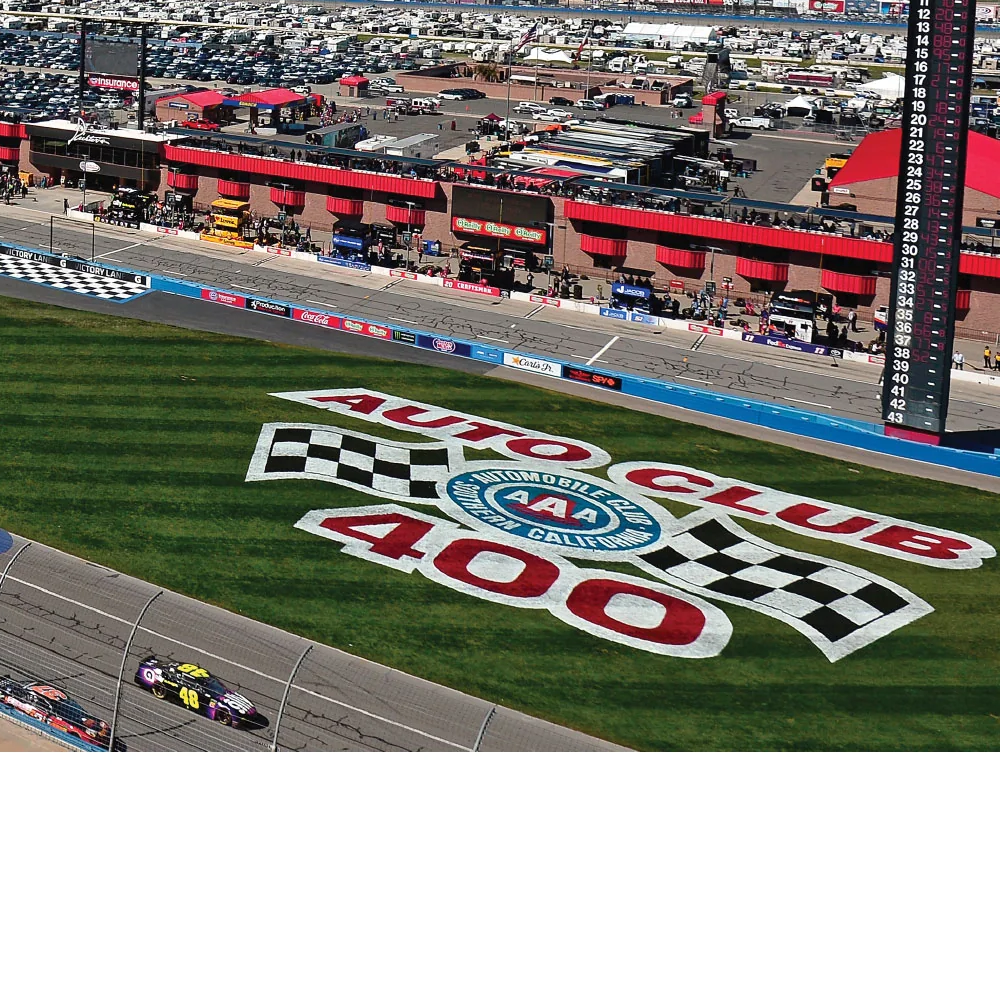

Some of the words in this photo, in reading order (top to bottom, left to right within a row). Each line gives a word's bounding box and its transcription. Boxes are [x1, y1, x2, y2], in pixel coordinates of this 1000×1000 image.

[917, 9, 930, 20] 12
[917, 22, 930, 33] 13
[916, 35, 929, 46] 14
[915, 48, 928, 59] 15
[914, 62, 928, 72] 16
[98, 77, 138, 89] Insurance
[913, 75, 926, 85] 17
[912, 88, 926, 98] 18
[912, 101, 925, 112] 19
[910, 114, 927, 125] 20
[910, 127, 923, 138] 21
[909, 140, 924, 151] 22
[908, 153, 923, 164] 23
[907, 166, 922, 177] 24
[906, 179, 921, 190] 25
[905, 192, 921, 203] 26
[904, 205, 919, 216] 27
[903, 218, 919, 230] 28
[902, 231, 918, 243] 29
[6, 248, 33, 260] VICTORY
[34, 254, 48, 262] LAN
[902, 244, 918, 256] 30
[901, 257, 914, 268] 31
[60, 260, 66, 268] G
[74, 263, 105, 275] VICTORY
[135, 276, 142, 284] G
[900, 270, 916, 282] 32
[444, 280, 453, 288] 20
[457, 282, 491, 294] CRAFTSMAN
[898, 282, 915, 294] 33
[256, 301, 285, 312] Production
[897, 296, 914, 308] 34
[897, 309, 913, 320] 35
[895, 322, 912, 334] 36
[766, 339, 786, 348] FedEx
[894, 335, 911, 347] 37
[894, 347, 910, 359] 38
[519, 358, 540, 368] Carl's
[541, 363, 553, 372] Jr.
[893, 360, 909, 372] 39
[892, 373, 909, 384] 40
[891, 386, 904, 398] 41
[890, 399, 906, 411] 42
[887, 412, 903, 424] 43
[307, 394, 592, 461] AUTO
[626, 468, 973, 560] CLUB
[471, 471, 612, 498] AUTOMOBILE
[607, 498, 653, 526] CLUB
[504, 490, 597, 523] AAA
[452, 481, 516, 531] SOUTHERN
[528, 528, 653, 549] CALIFORNIA
[318, 512, 706, 645] 400
[180, 686, 199, 710] 48
